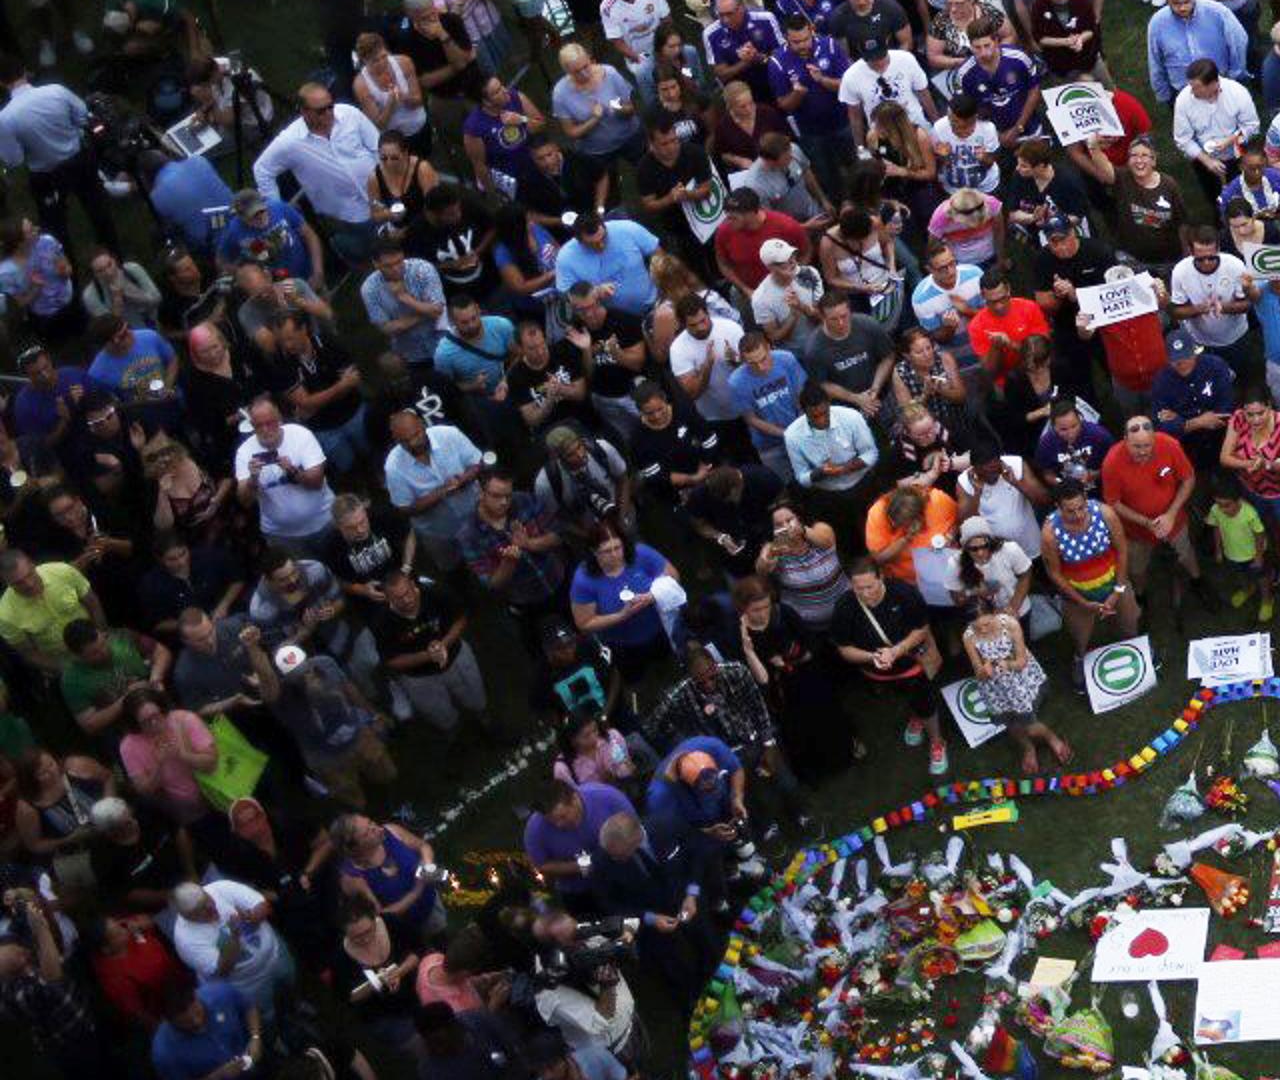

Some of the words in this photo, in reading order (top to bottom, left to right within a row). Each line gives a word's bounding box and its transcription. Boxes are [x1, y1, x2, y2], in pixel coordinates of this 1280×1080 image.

[1069, 105, 1097, 120] LOVE
[1074, 117, 1101, 130] HATE
[1098, 286, 1131, 302] LOVE
[1102, 299, 1135, 315] HATE
[1208, 656, 1239, 671] LOVE
